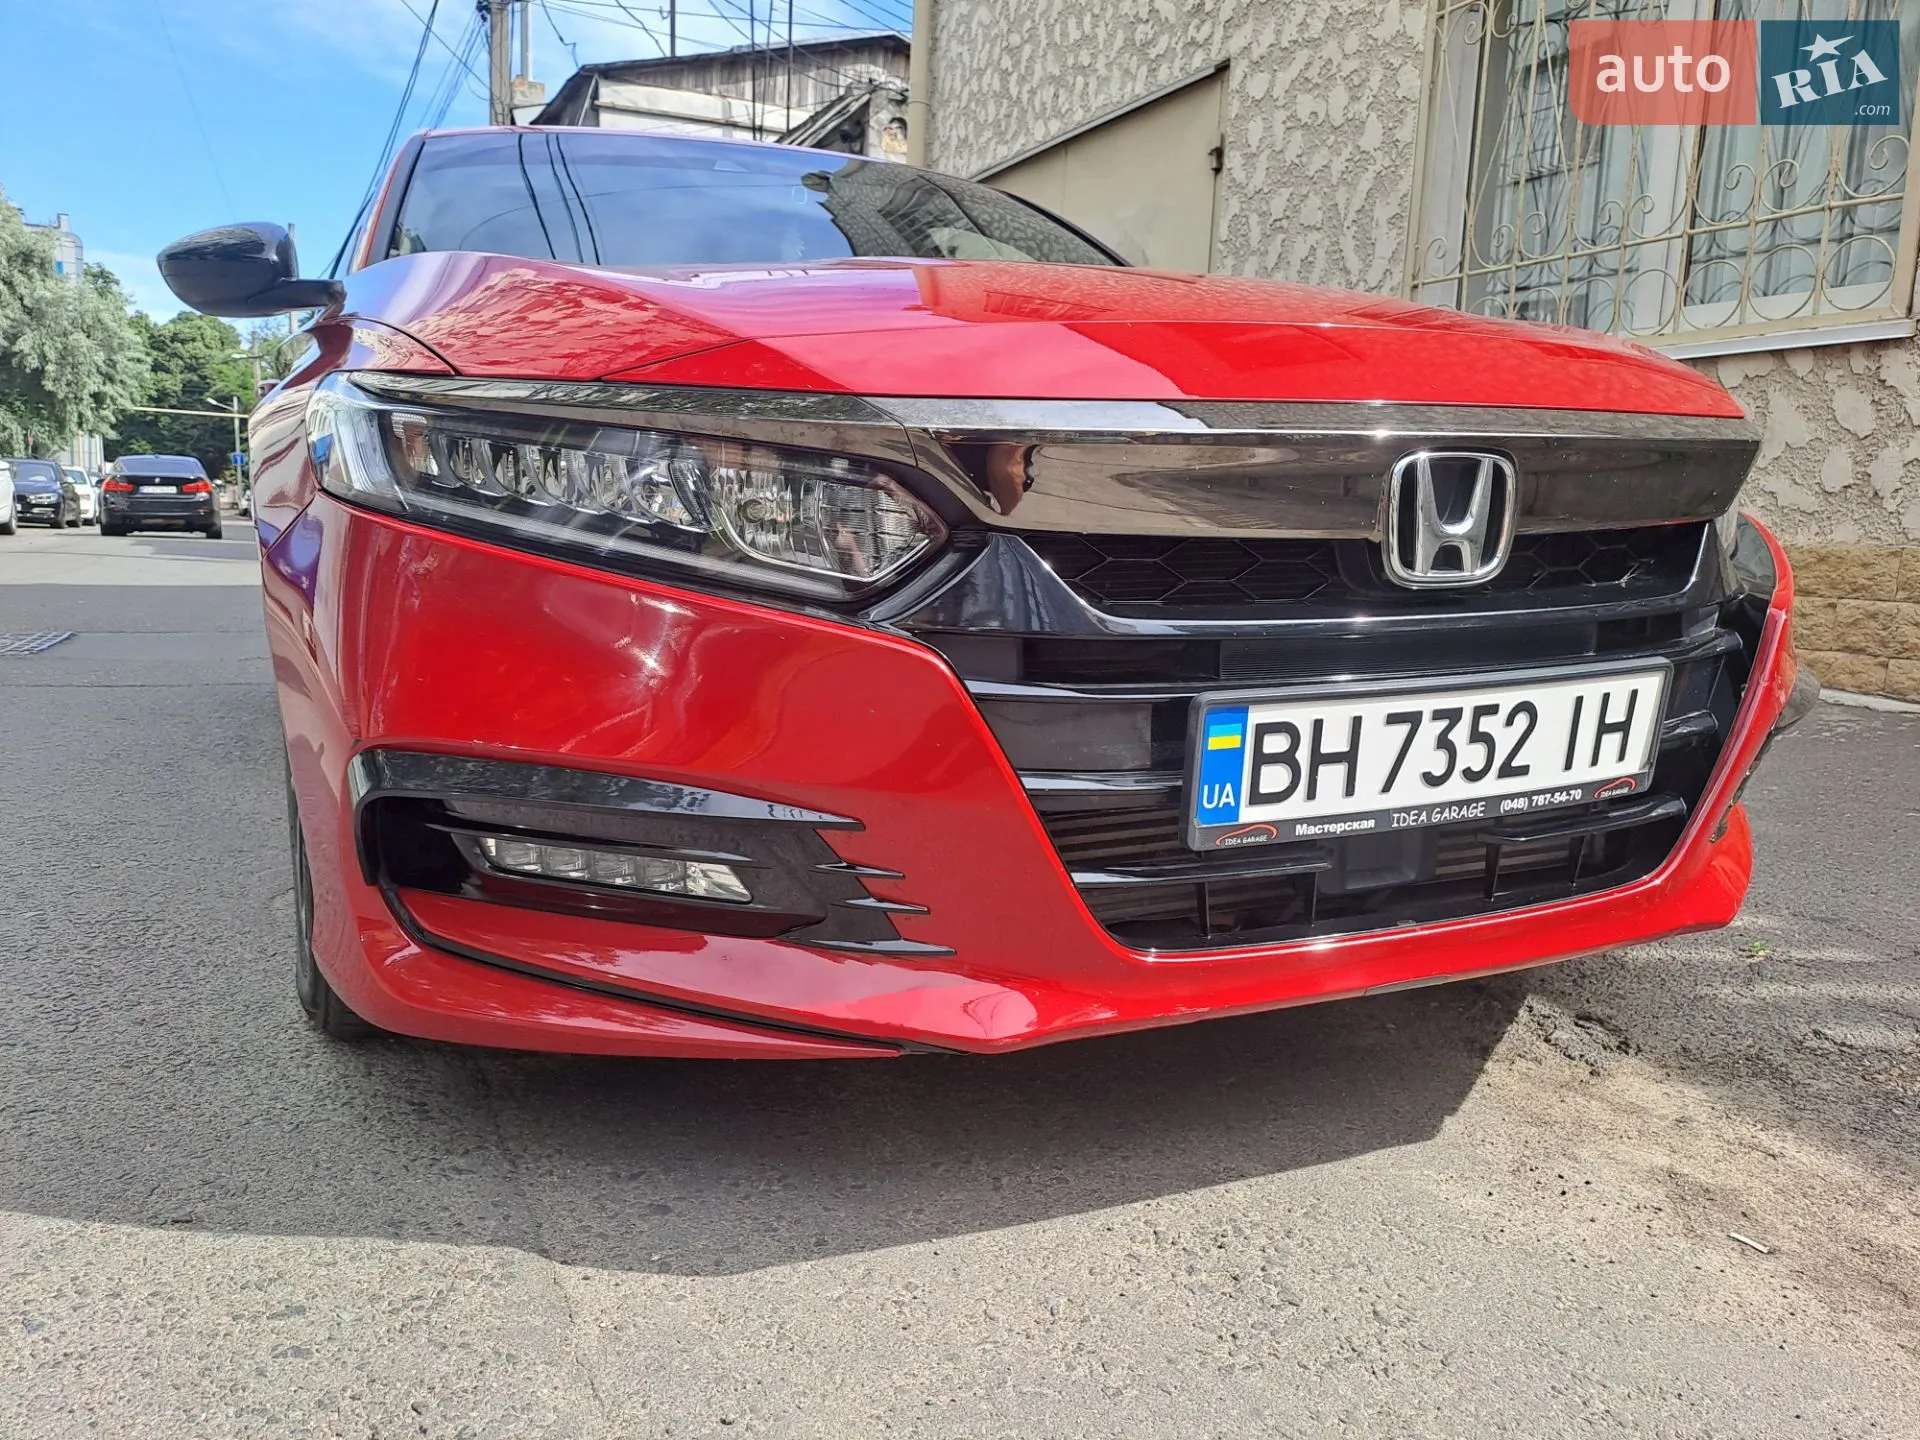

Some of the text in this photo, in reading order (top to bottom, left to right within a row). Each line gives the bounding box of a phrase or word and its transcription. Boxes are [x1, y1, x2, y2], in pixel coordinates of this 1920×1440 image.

[1248, 688, 1639, 806] BH 7352 IH
[1202, 783, 1235, 809] UA
[1500, 788, 1582, 814] (048) 787-54-70
[1295, 818, 1376, 836] Мастерская
[1391, 801, 1487, 828] IDEA GARAGE
[1225, 837, 1242, 846] IDEA
